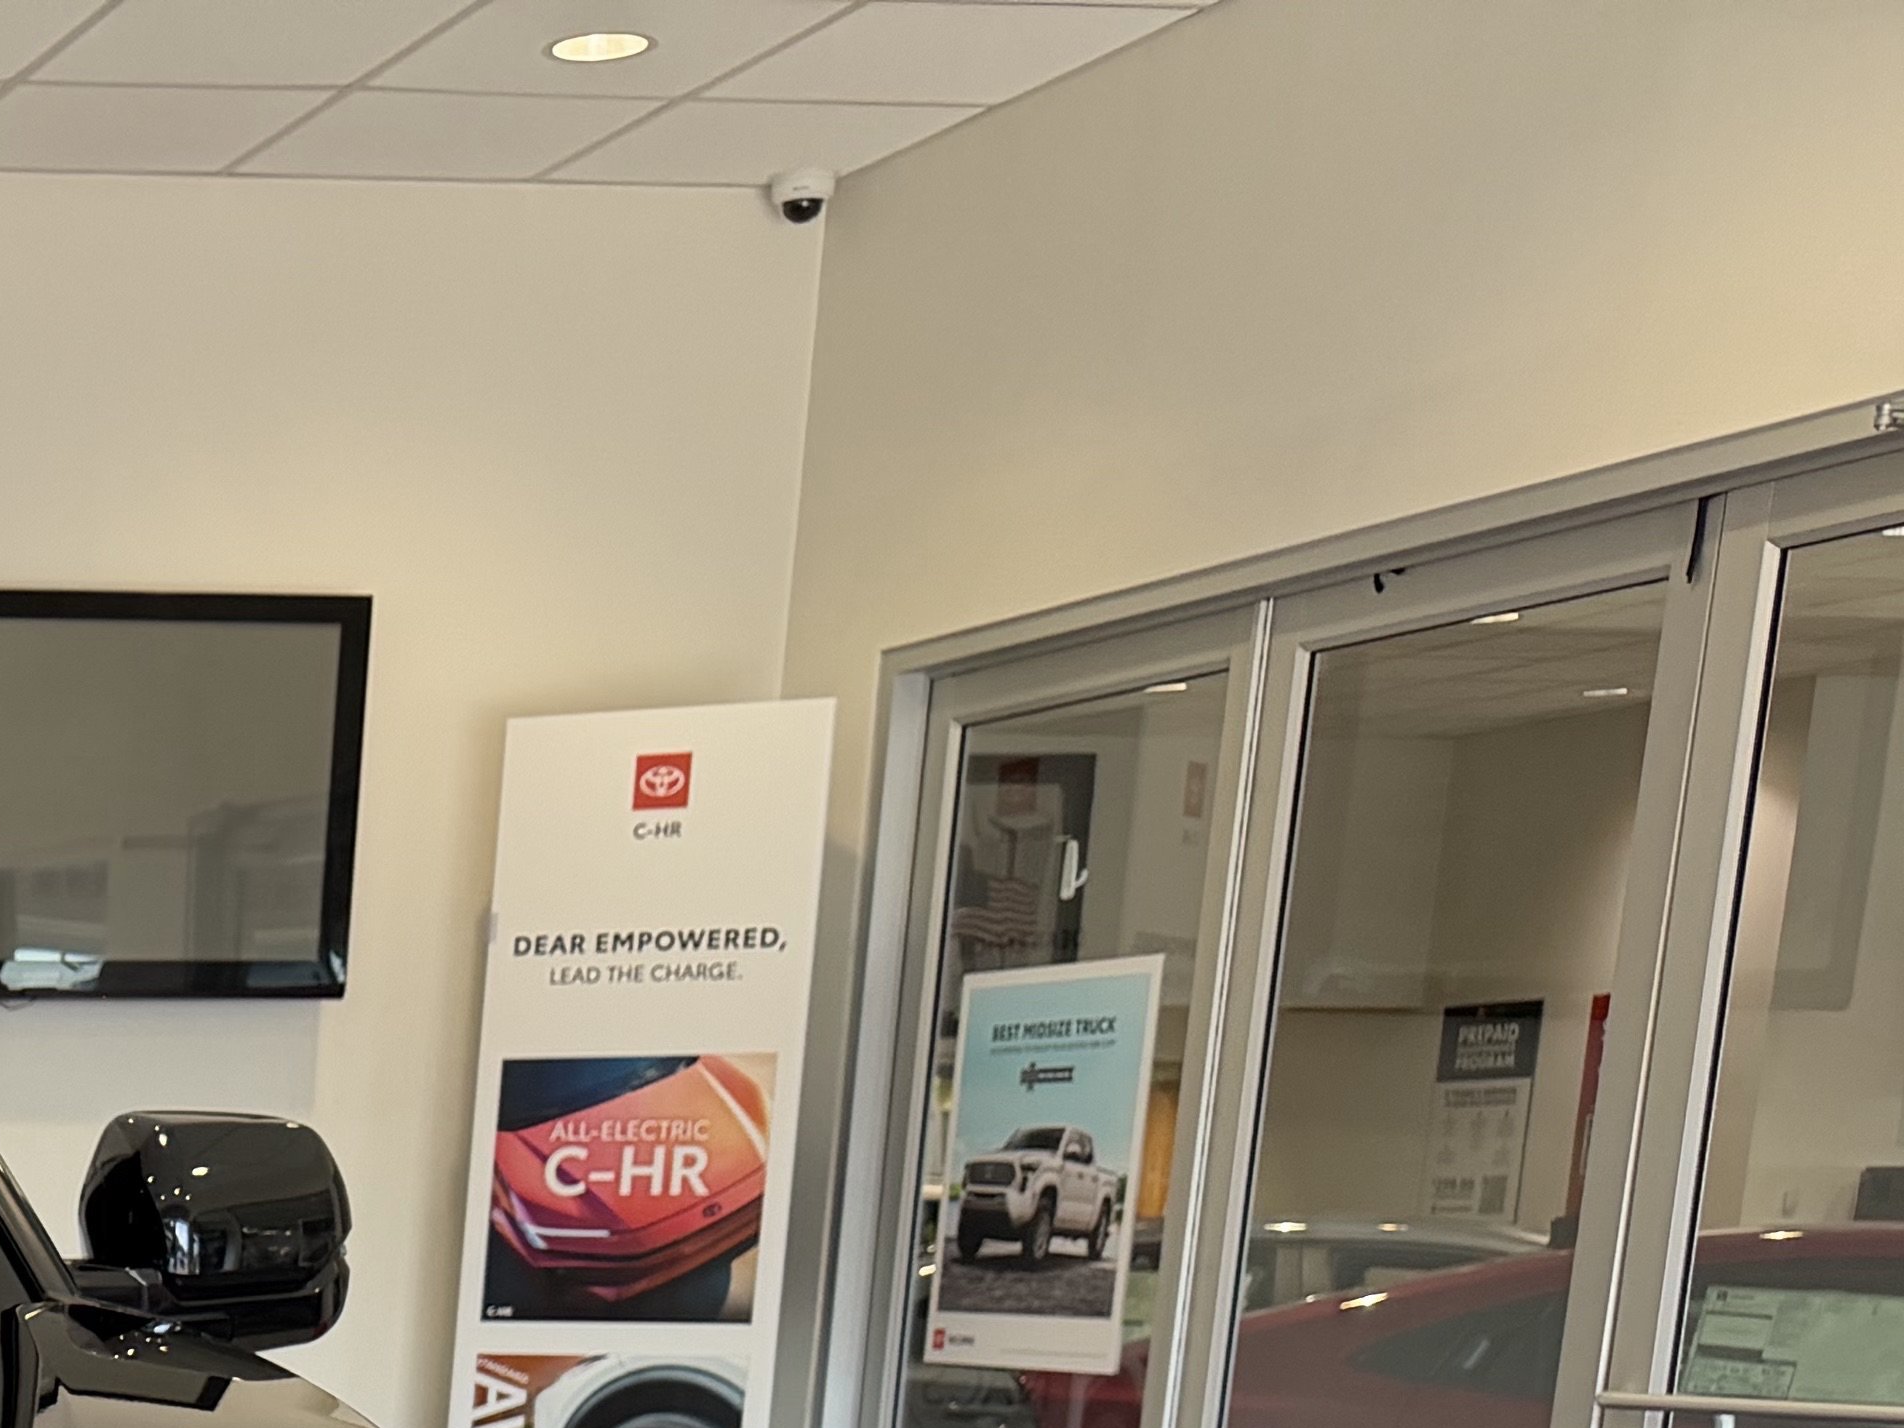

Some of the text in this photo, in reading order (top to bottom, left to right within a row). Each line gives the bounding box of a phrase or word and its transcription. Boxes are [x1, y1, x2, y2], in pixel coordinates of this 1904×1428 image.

[632, 821, 682, 840] C-HR
[513, 927, 788, 957] DEAR EMPOWERED,
[549, 961, 744, 986] LEAD THE CHARGE.
[992, 1016, 1117, 1042] BEST MIDSIZE TRUCK
[549, 1118, 712, 1143] ALL-ELECTRIC
[544, 1144, 711, 1198] C-HR
